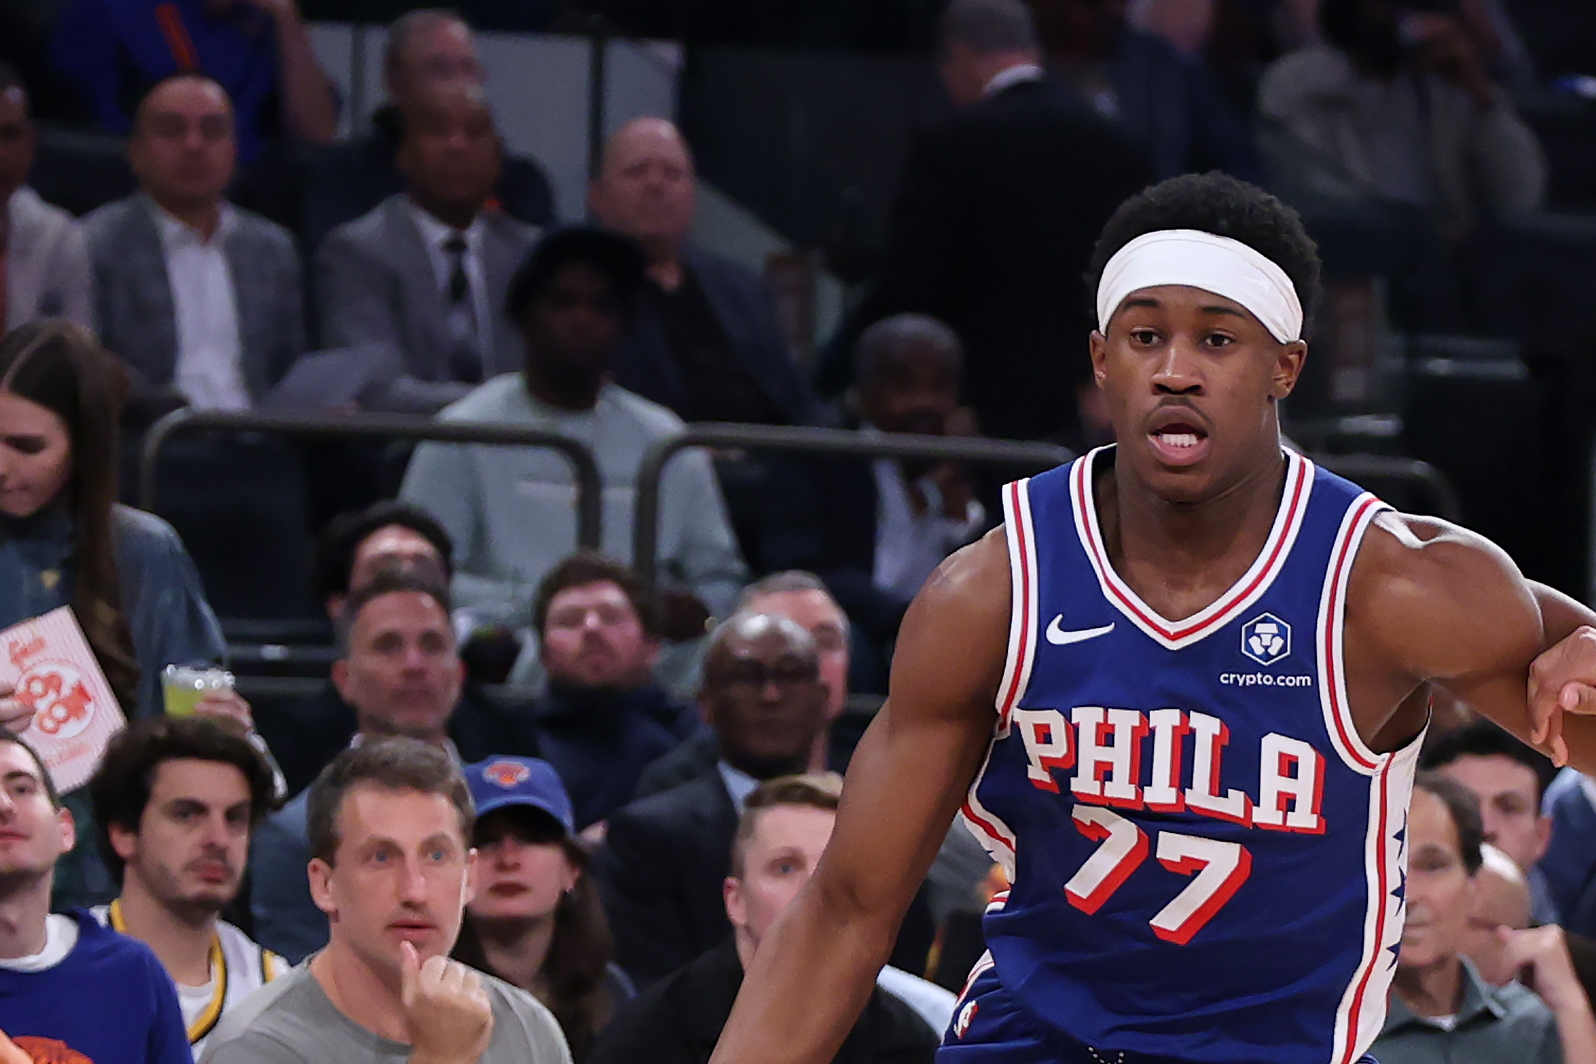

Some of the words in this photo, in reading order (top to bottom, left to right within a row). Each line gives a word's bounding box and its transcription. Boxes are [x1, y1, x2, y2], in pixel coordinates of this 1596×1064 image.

[1219, 671, 1312, 686] crypto.com
[1013, 706, 1327, 835] PHILA
[1063, 803, 1253, 945] 77
